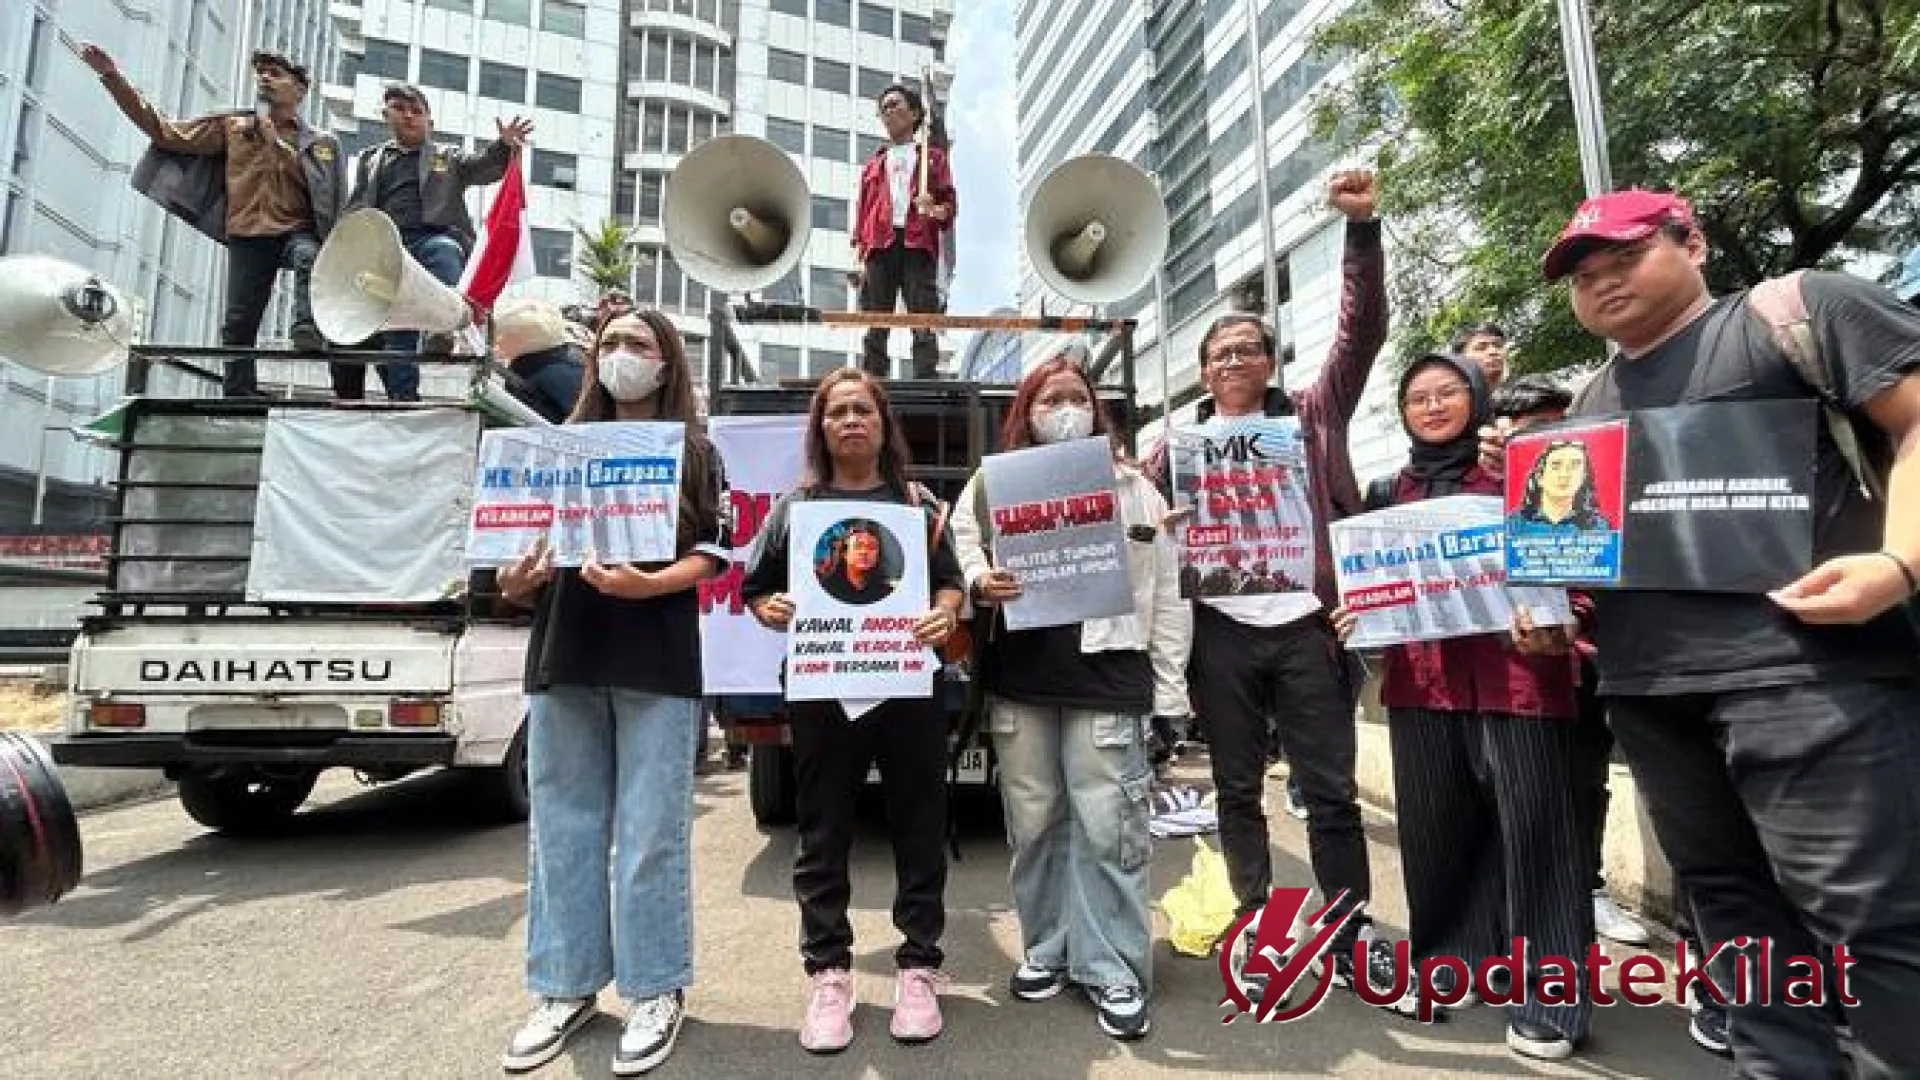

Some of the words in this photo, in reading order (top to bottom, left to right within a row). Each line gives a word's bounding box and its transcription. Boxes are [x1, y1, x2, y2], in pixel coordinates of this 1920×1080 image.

[1205, 433, 1265, 462] MK
[1342, 555, 1367, 574] MK
[795, 618, 854, 634] KAWAL
[795, 641, 846, 655] KAWAL
[853, 639, 923, 654] KEADILAN
[140, 660, 392, 682] DAIHATSU
[833, 660, 899, 674] BERSAMA
